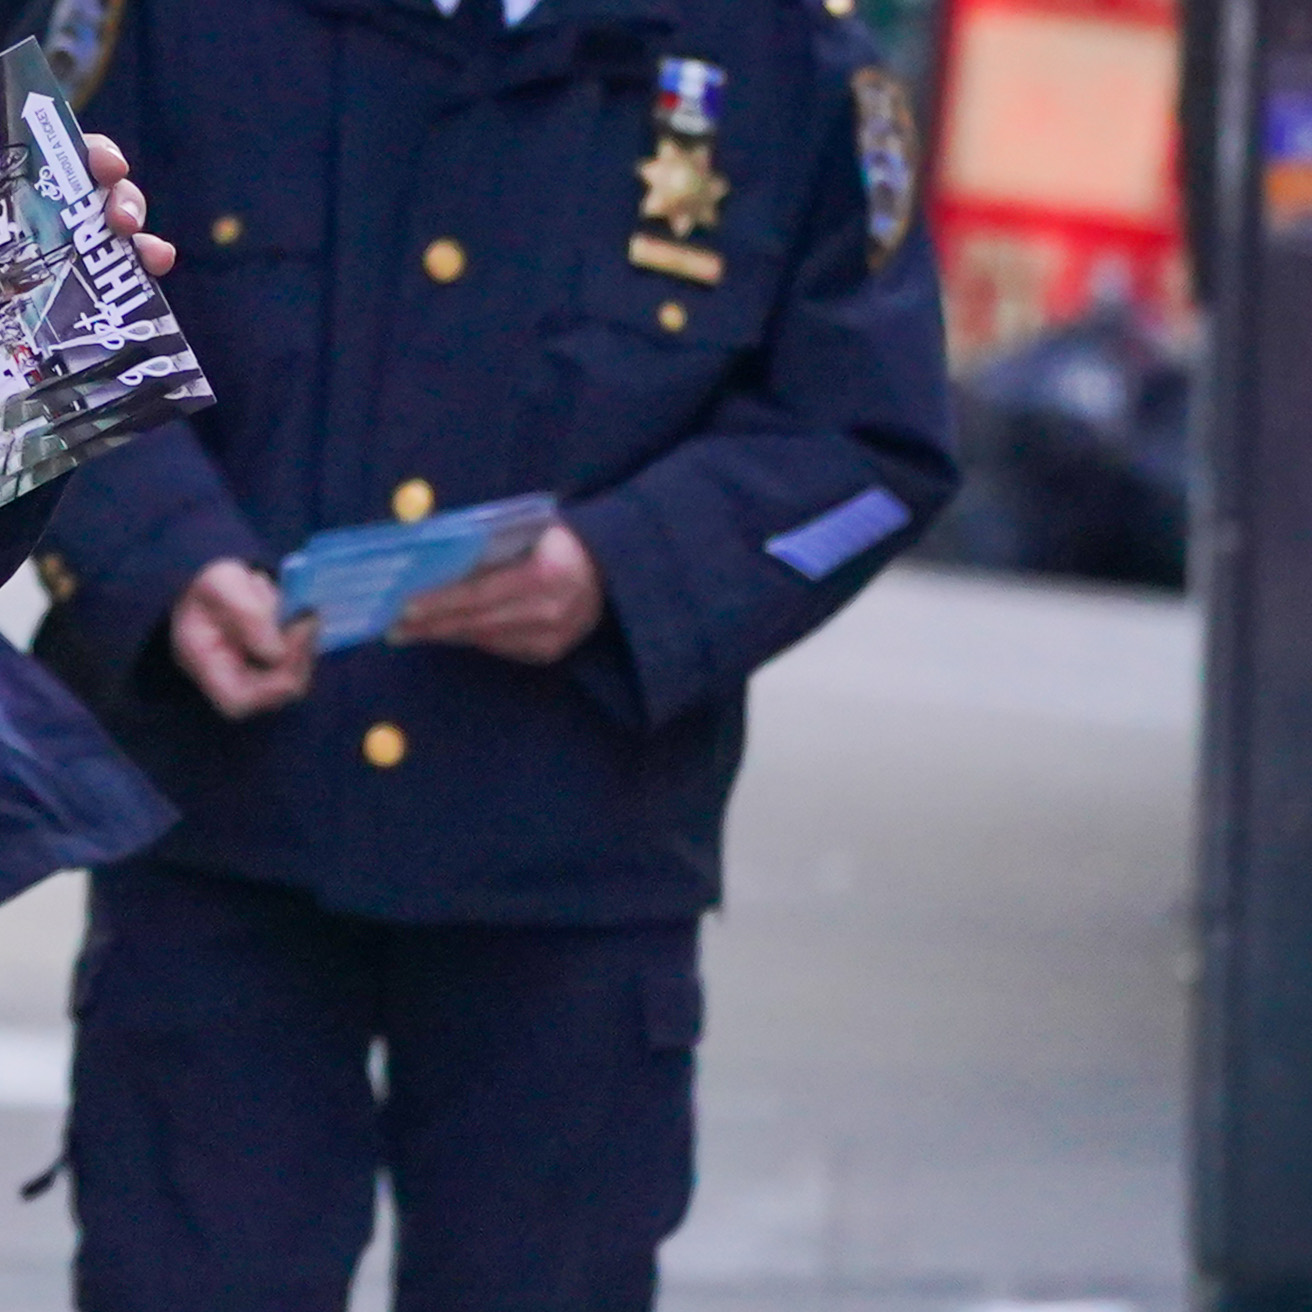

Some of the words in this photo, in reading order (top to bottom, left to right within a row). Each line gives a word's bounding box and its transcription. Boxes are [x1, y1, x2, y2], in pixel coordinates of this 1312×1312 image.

[34, 108, 57, 143] TICKET
[52, 141, 63, 150] A
[56, 150, 83, 195] WITHOUT
[60, 189, 155, 326] THERE
